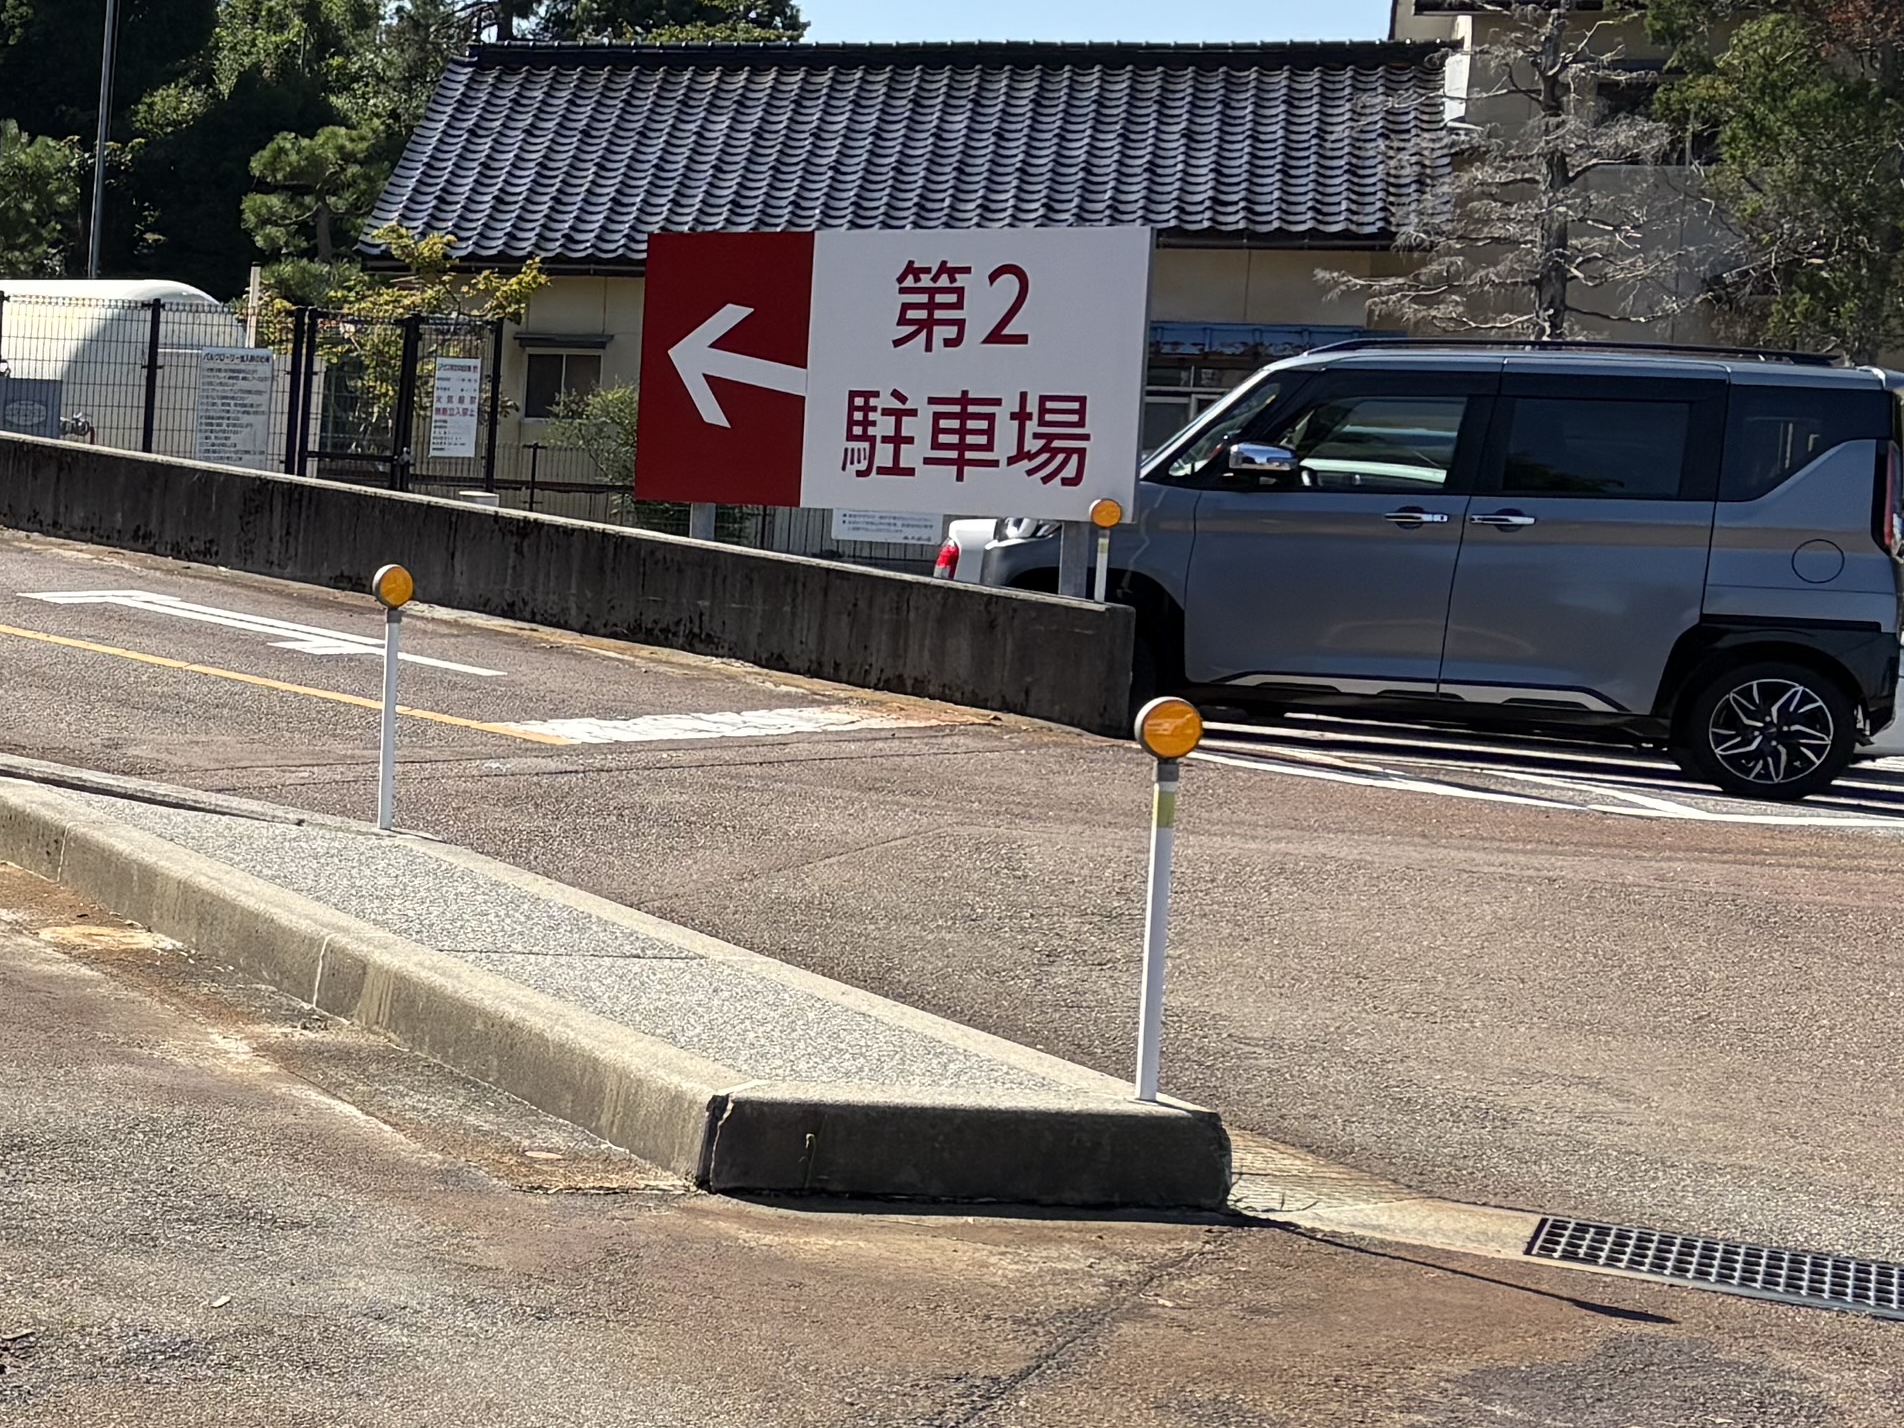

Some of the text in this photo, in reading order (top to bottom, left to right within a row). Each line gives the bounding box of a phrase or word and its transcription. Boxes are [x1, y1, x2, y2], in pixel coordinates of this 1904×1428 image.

[891, 259, 1030, 353] 第2
[840, 388, 1091, 488] 駐車場
